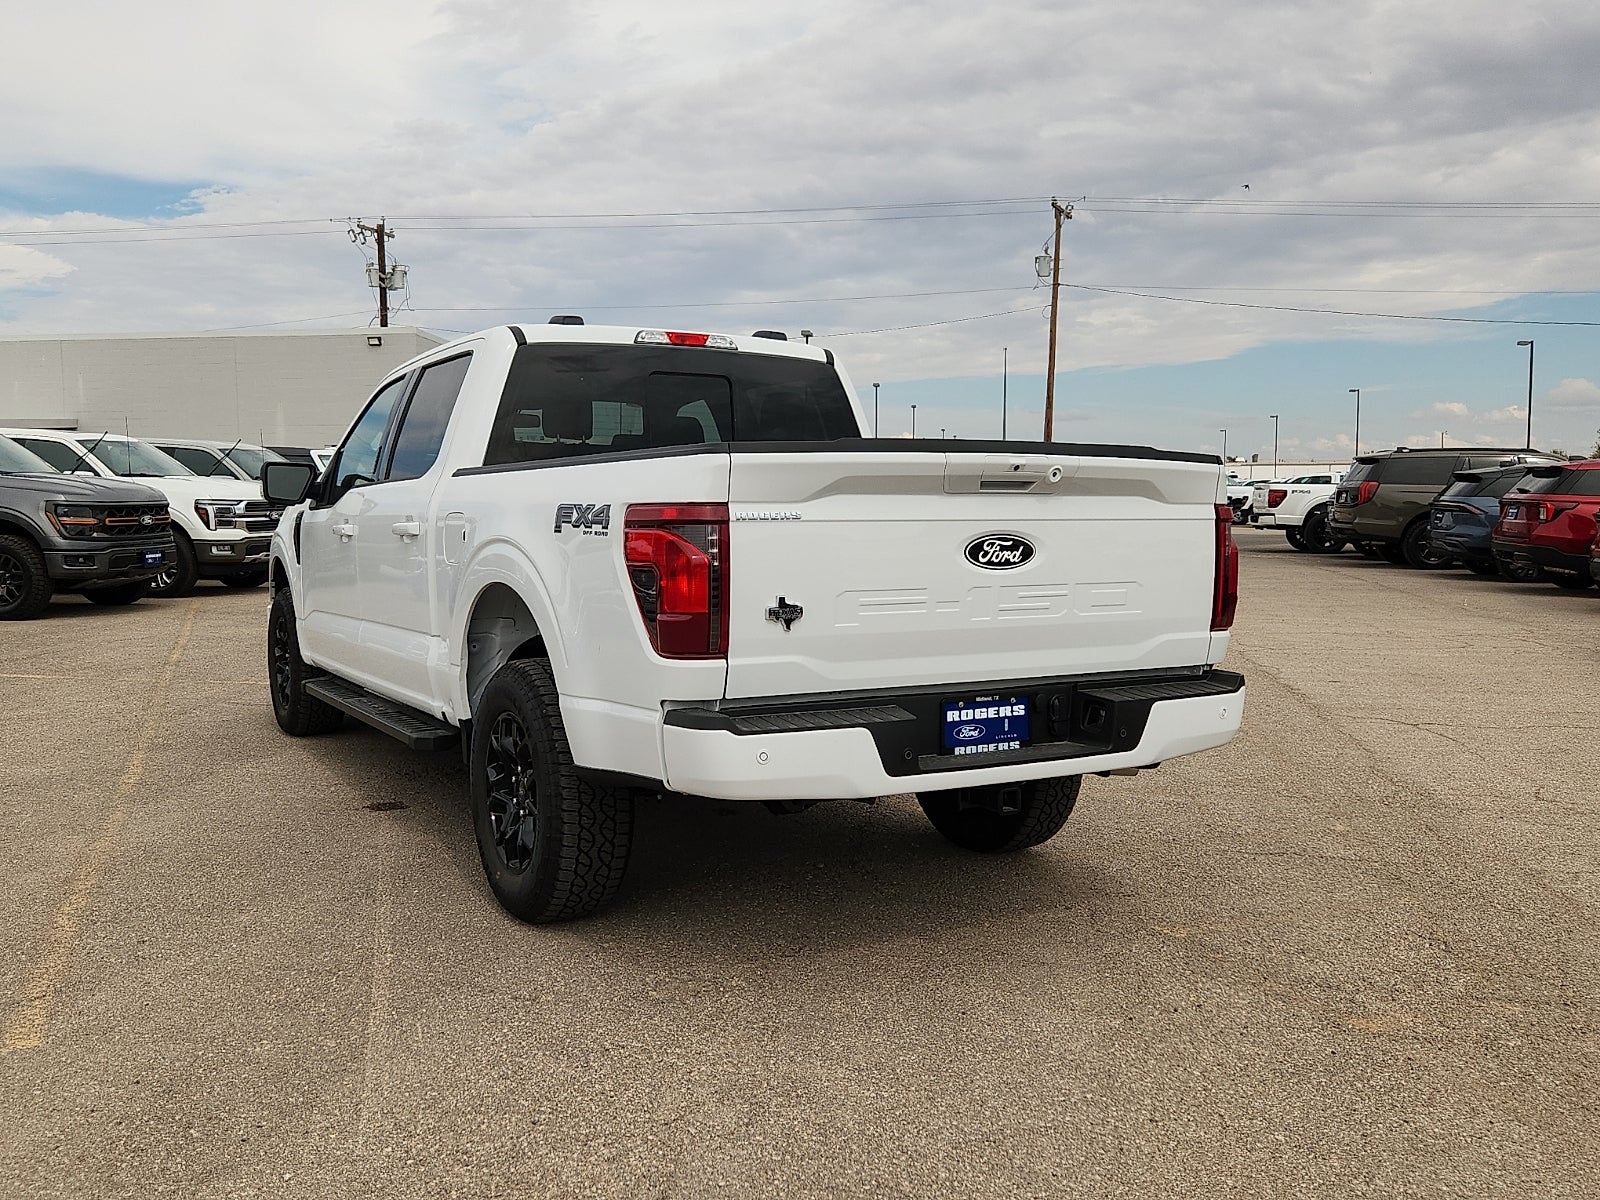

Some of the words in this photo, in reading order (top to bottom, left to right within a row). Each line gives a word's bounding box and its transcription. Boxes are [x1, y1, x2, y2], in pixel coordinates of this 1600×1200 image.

[553, 503, 611, 533] FX4
[735, 511, 801, 520] ROGERS
[978, 538, 1024, 564] Ford
[833, 580, 1144, 627] F-150
[946, 704, 1026, 722] ROGERS
[959, 726, 980, 738] Ford
[954, 740, 1020, 755] ROGERS
